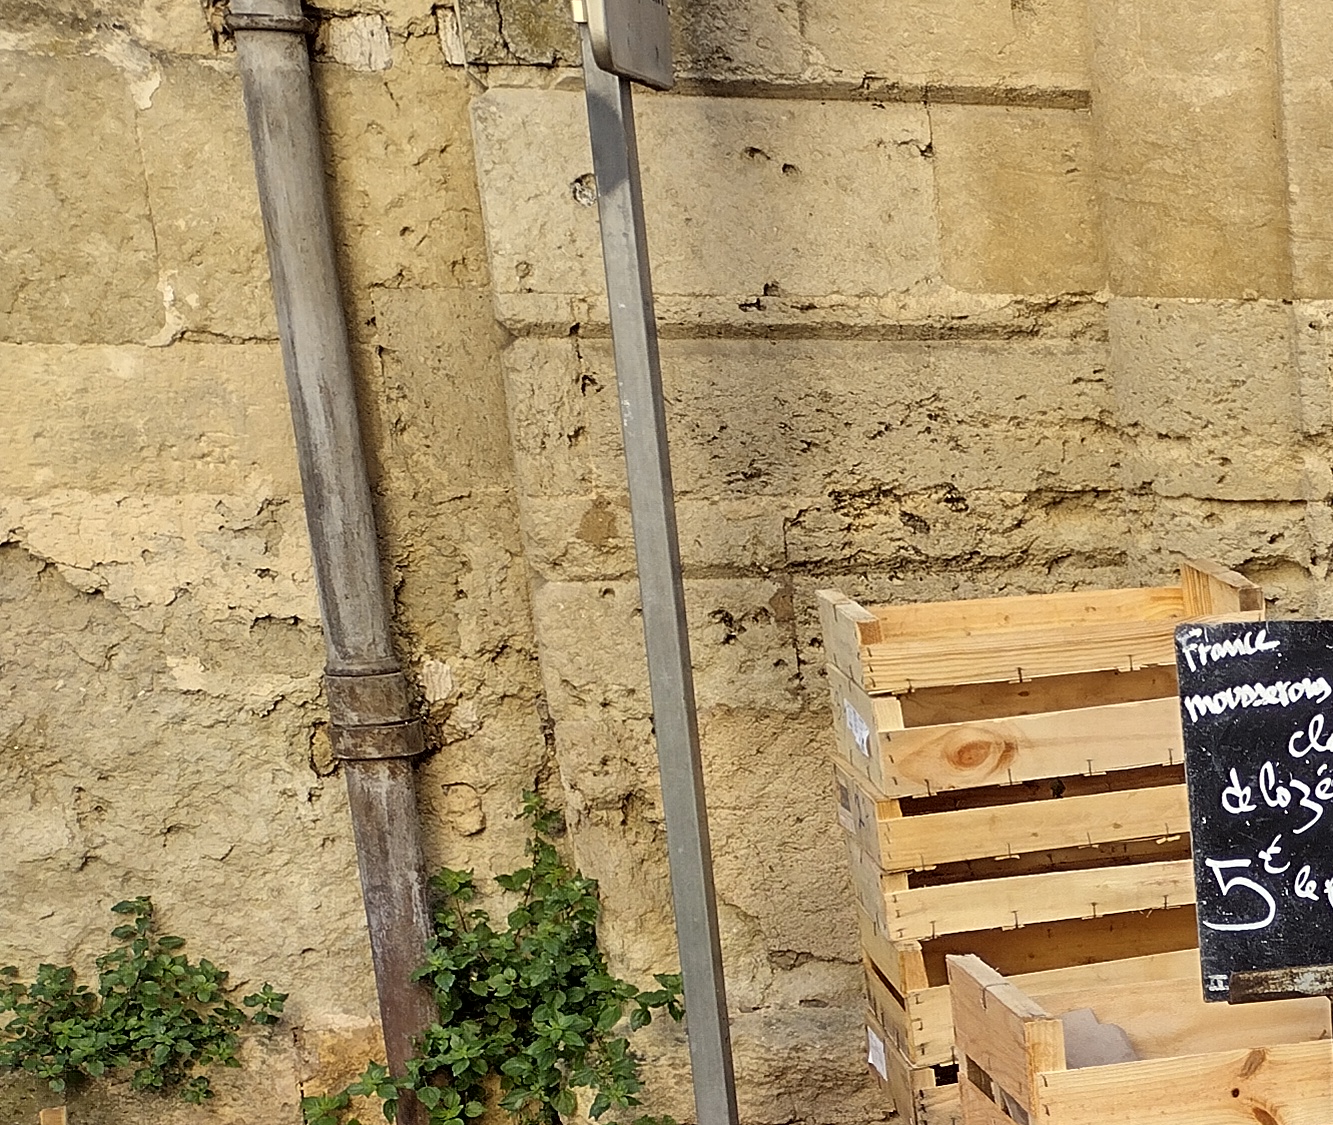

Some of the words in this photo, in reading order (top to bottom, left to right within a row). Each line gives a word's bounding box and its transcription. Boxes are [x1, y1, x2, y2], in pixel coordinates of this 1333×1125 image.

[1181, 628, 1279, 672] France
[1222, 767, 1256, 814] de
[1294, 869, 1320, 901] le
